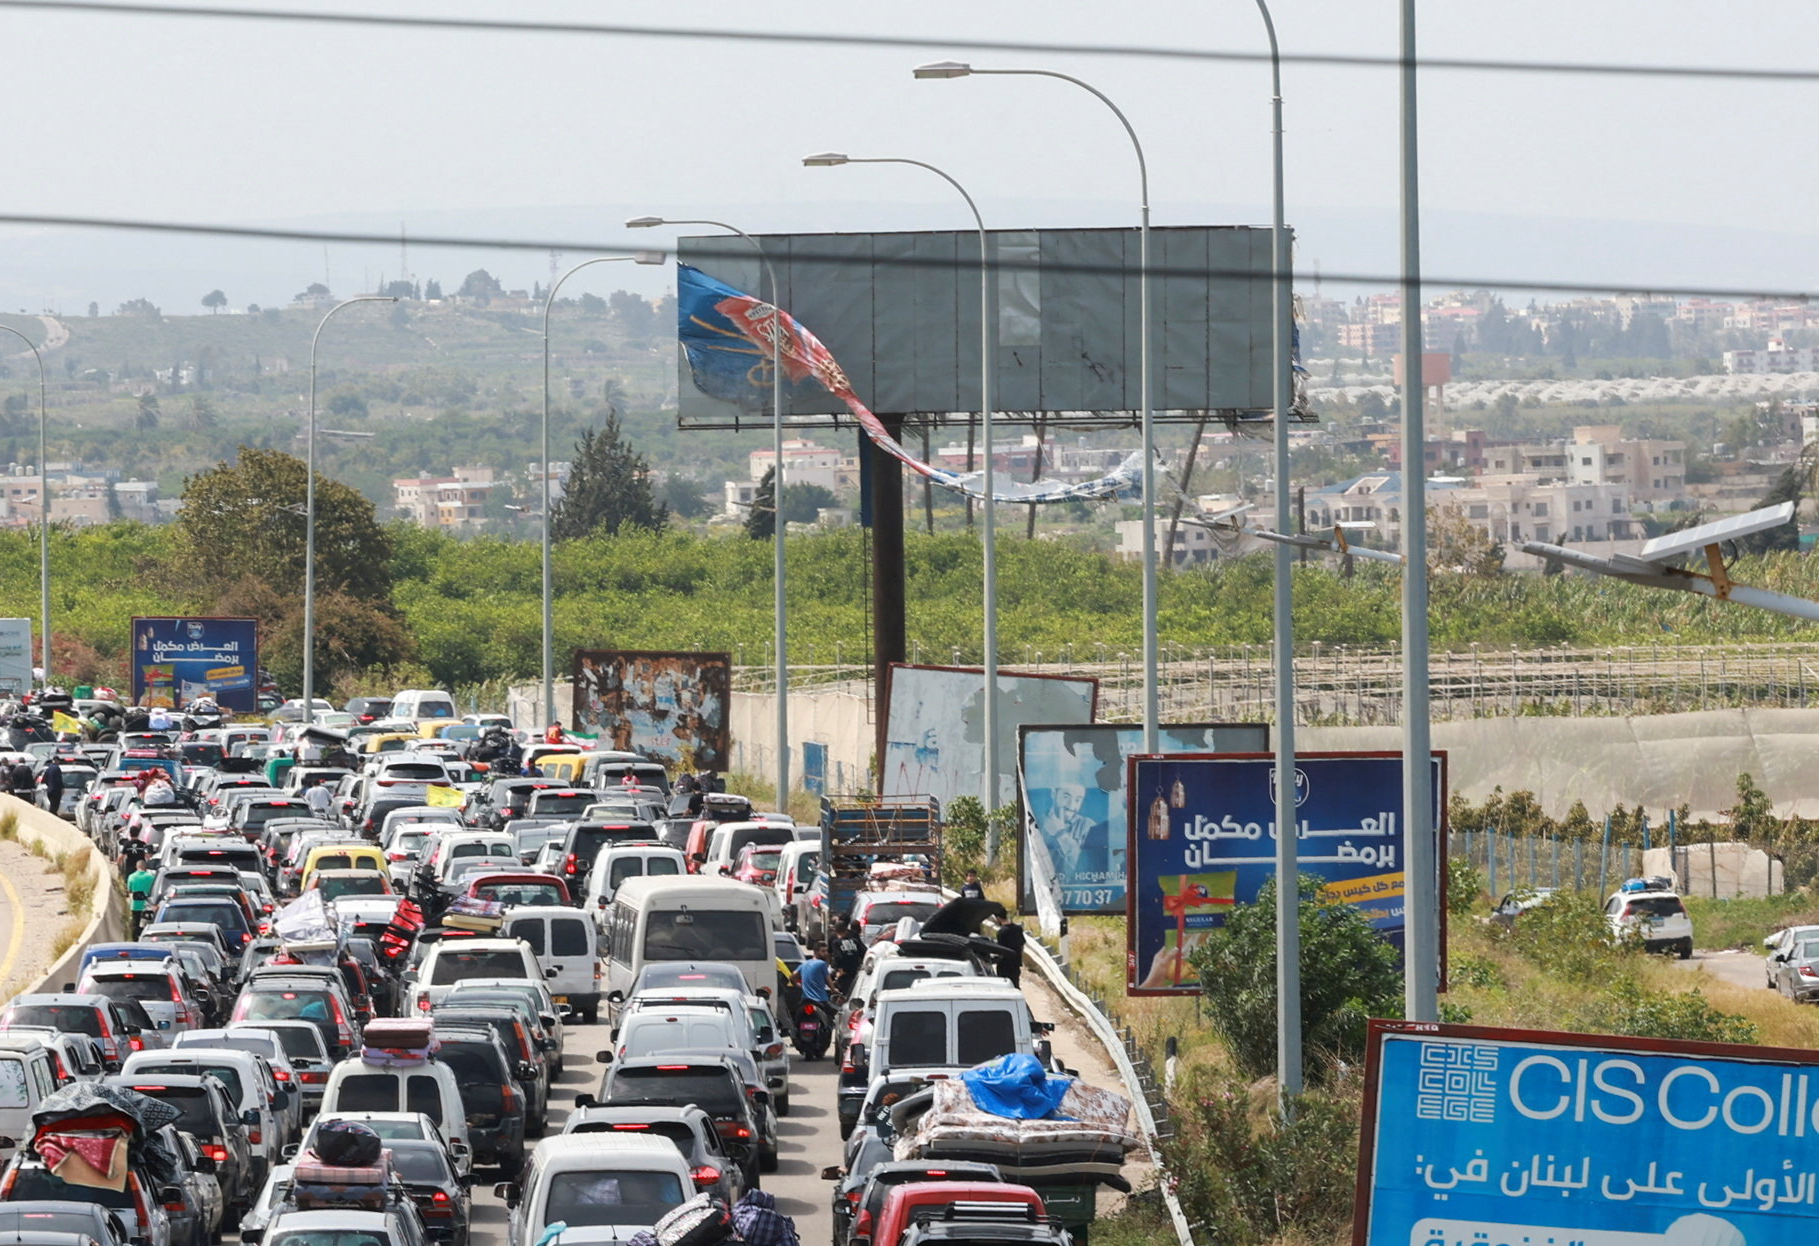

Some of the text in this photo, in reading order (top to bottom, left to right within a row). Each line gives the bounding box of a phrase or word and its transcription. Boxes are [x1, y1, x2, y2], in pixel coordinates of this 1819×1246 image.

[1509, 1054, 1819, 1138] CIS Coll
[1500, 1154, 1590, 1197] لبنان
[1601, 1161, 1684, 1200] على
[1698, 1158, 1816, 1211] الأولى
